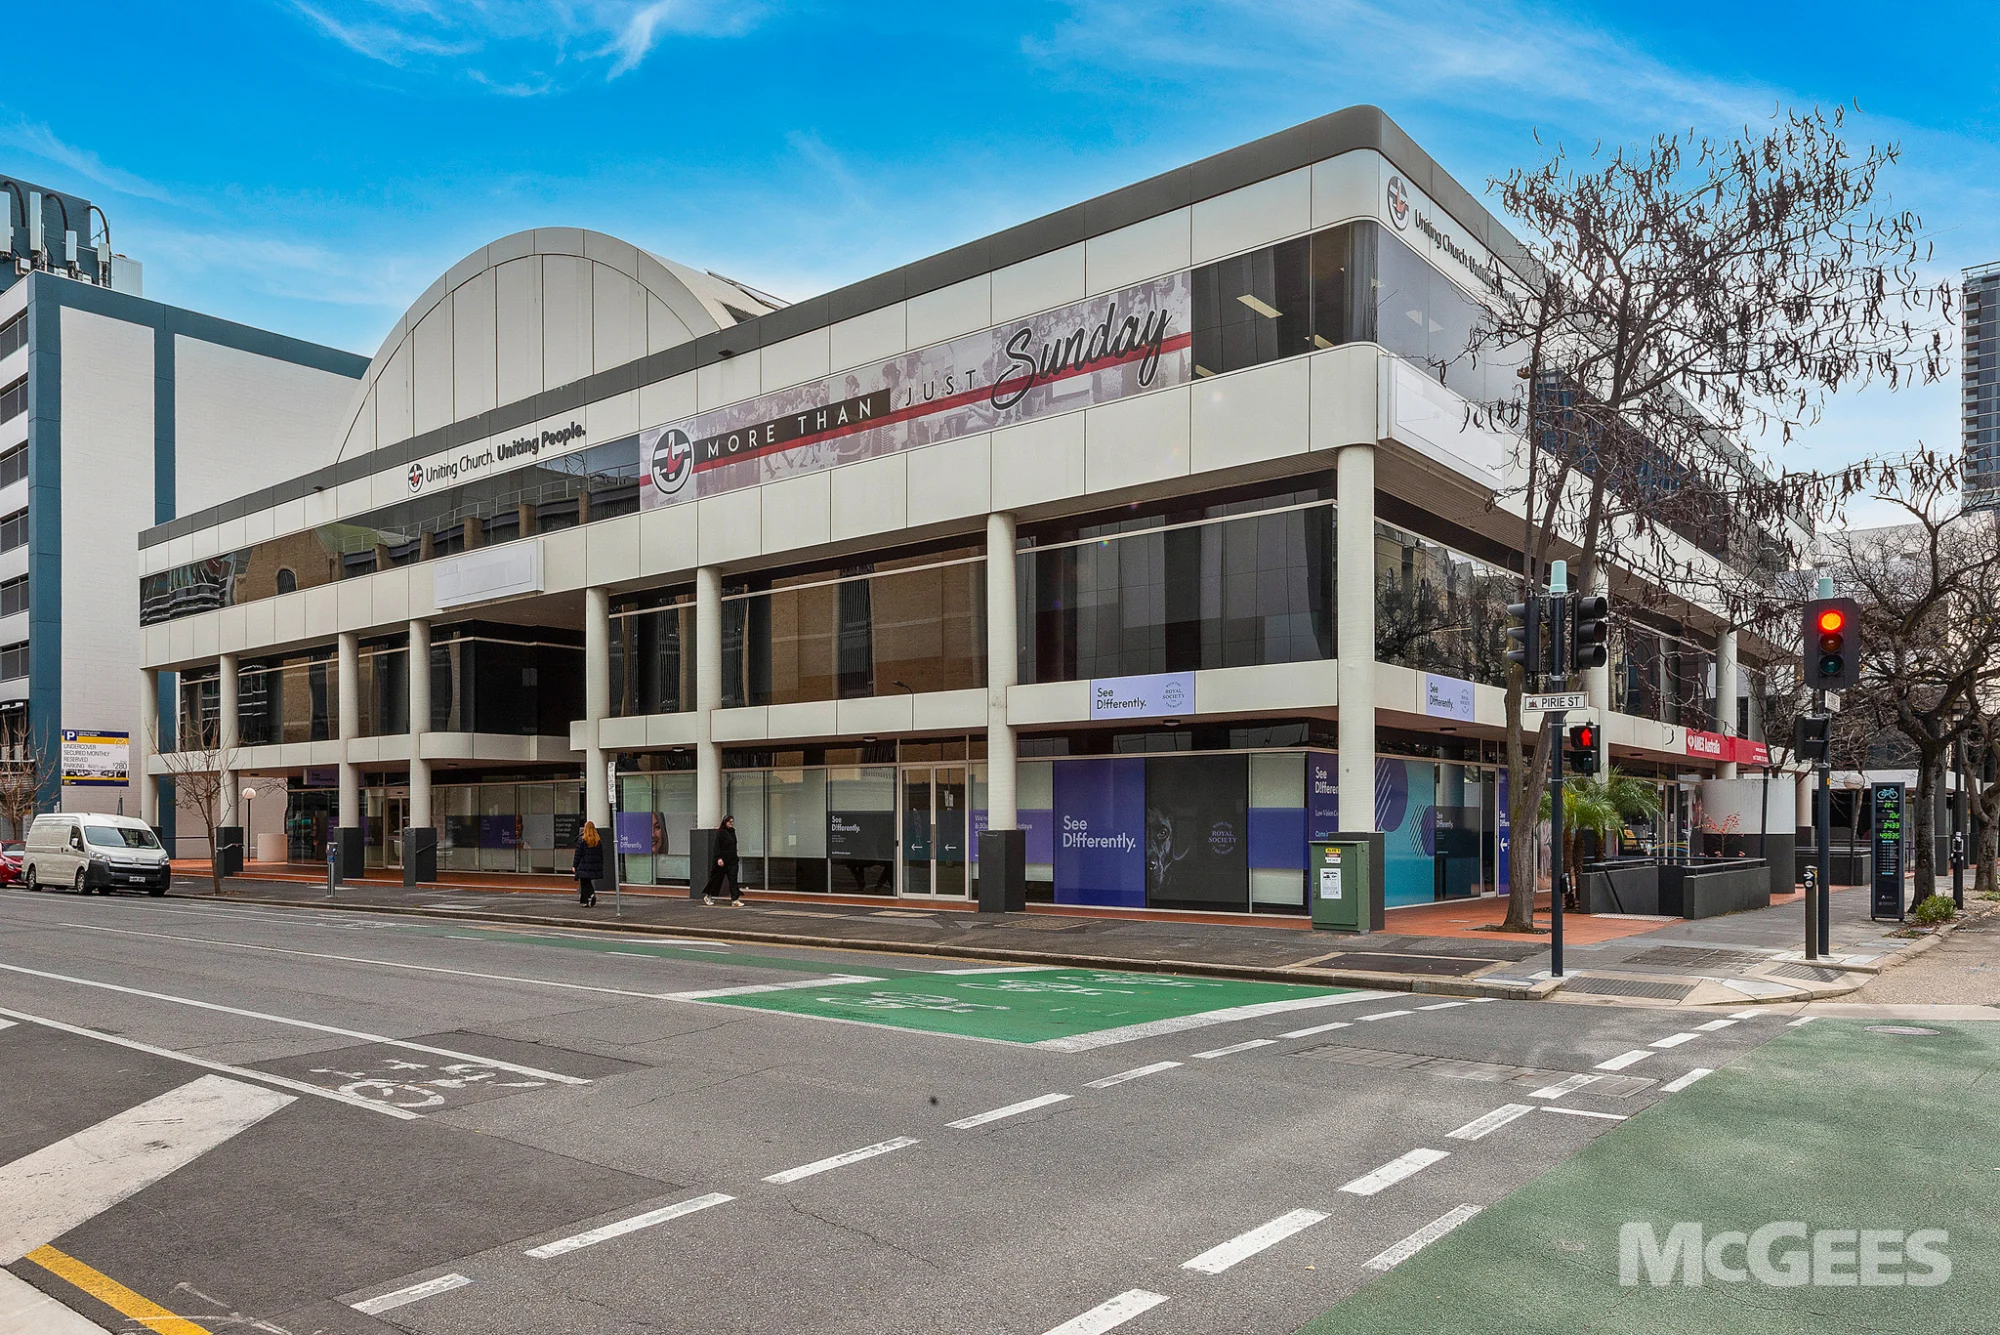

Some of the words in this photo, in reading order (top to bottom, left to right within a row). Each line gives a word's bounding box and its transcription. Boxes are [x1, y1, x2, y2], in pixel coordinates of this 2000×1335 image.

[1415, 209, 1442, 249] Uniting
[1442, 234, 1469, 268] Church.
[707, 424, 775, 459] MORE
[797, 398, 871, 434] THAN
[905, 369, 976, 406] JUST
[990, 302, 1172, 411] Sunday
[425, 462, 457, 482] Uniting
[459, 449, 495, 473] Church.
[497, 437, 539, 462] Uniting
[541, 421, 587, 448] People.
[1097, 687, 1114, 697] See
[1430, 682, 1438, 693] See
[1541, 697, 1565, 708] PIRIE
[1568, 696, 1580, 707] ST
[66, 731, 76, 741] P
[1315, 766, 1328, 779] See
[832, 815, 842, 823] See
[1063, 815, 1088, 831] See
